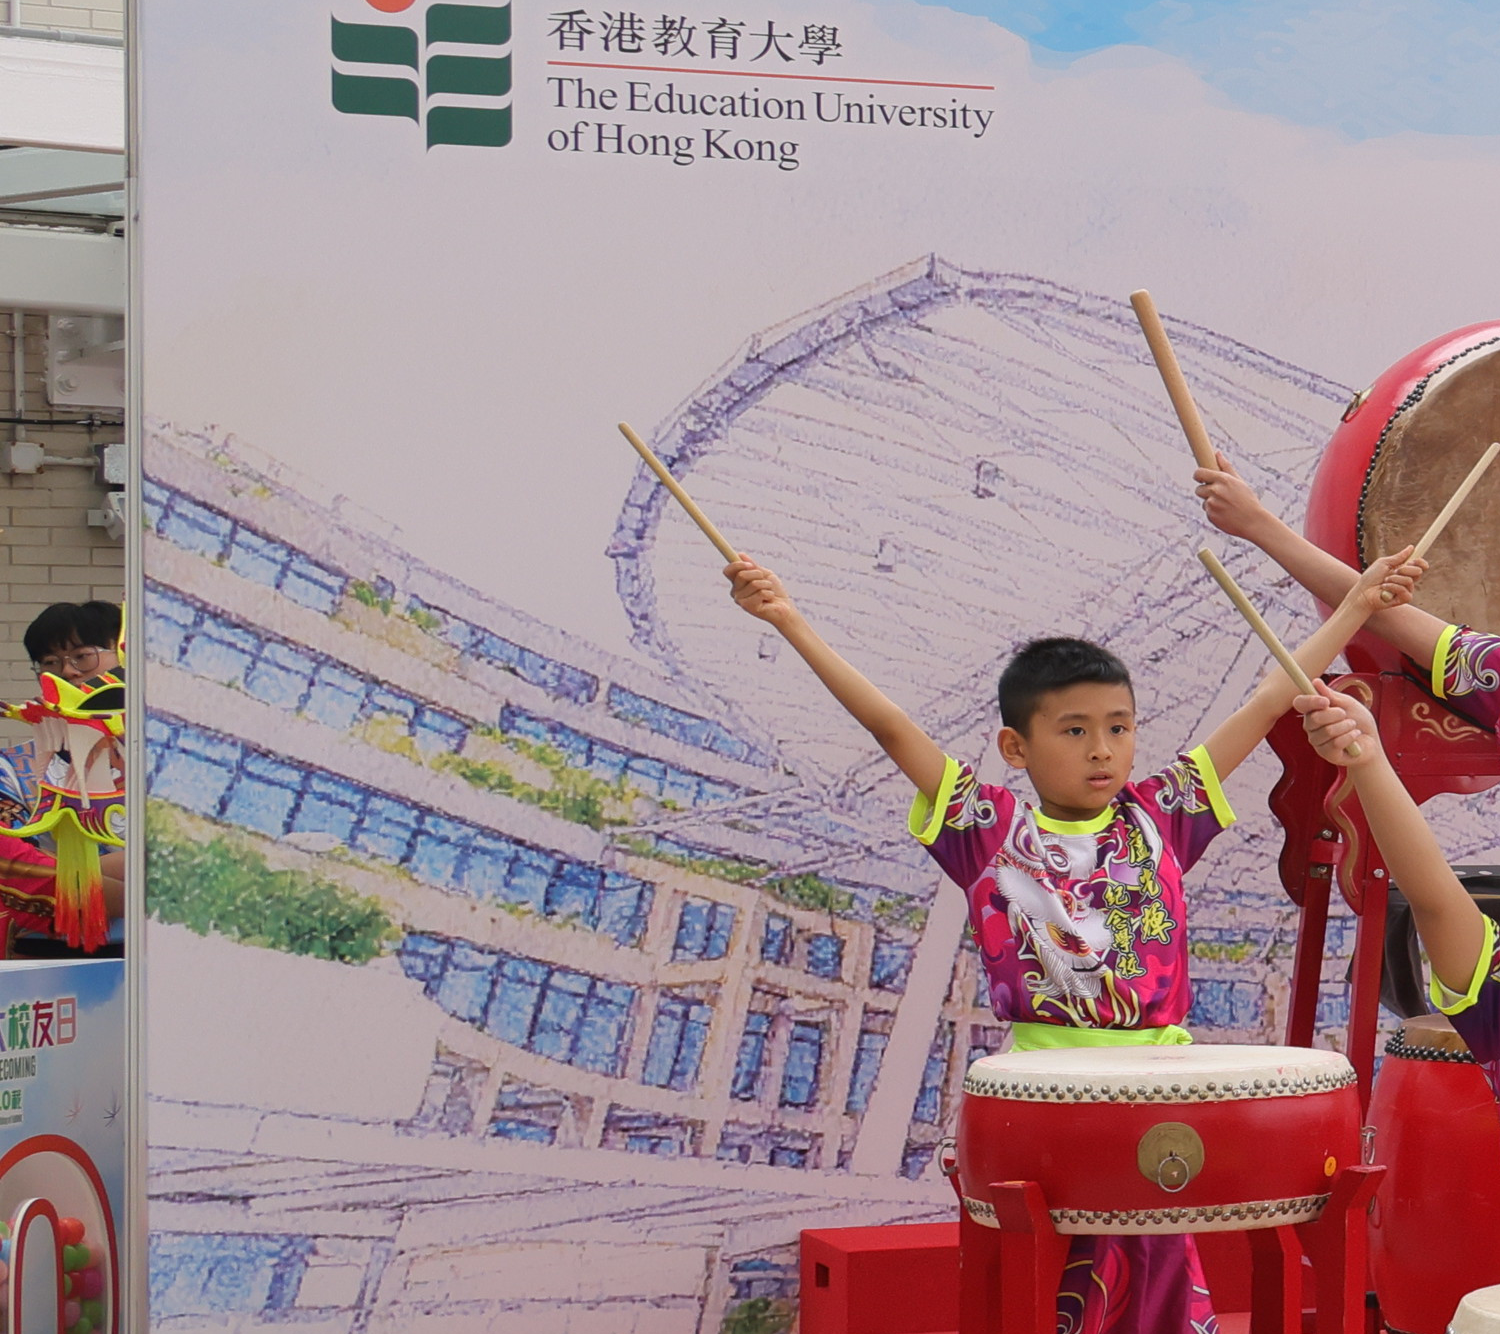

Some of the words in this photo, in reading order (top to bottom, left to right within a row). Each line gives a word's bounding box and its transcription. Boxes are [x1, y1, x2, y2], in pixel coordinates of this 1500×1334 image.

[547, 9, 843, 66] 香港教育大學
[547, 77, 618, 110] The
[627, 81, 806, 121] Education
[813, 91, 995, 138] University
[547, 120, 589, 152] of
[594, 123, 695, 166] Hong
[702, 129, 800, 171] Kong
